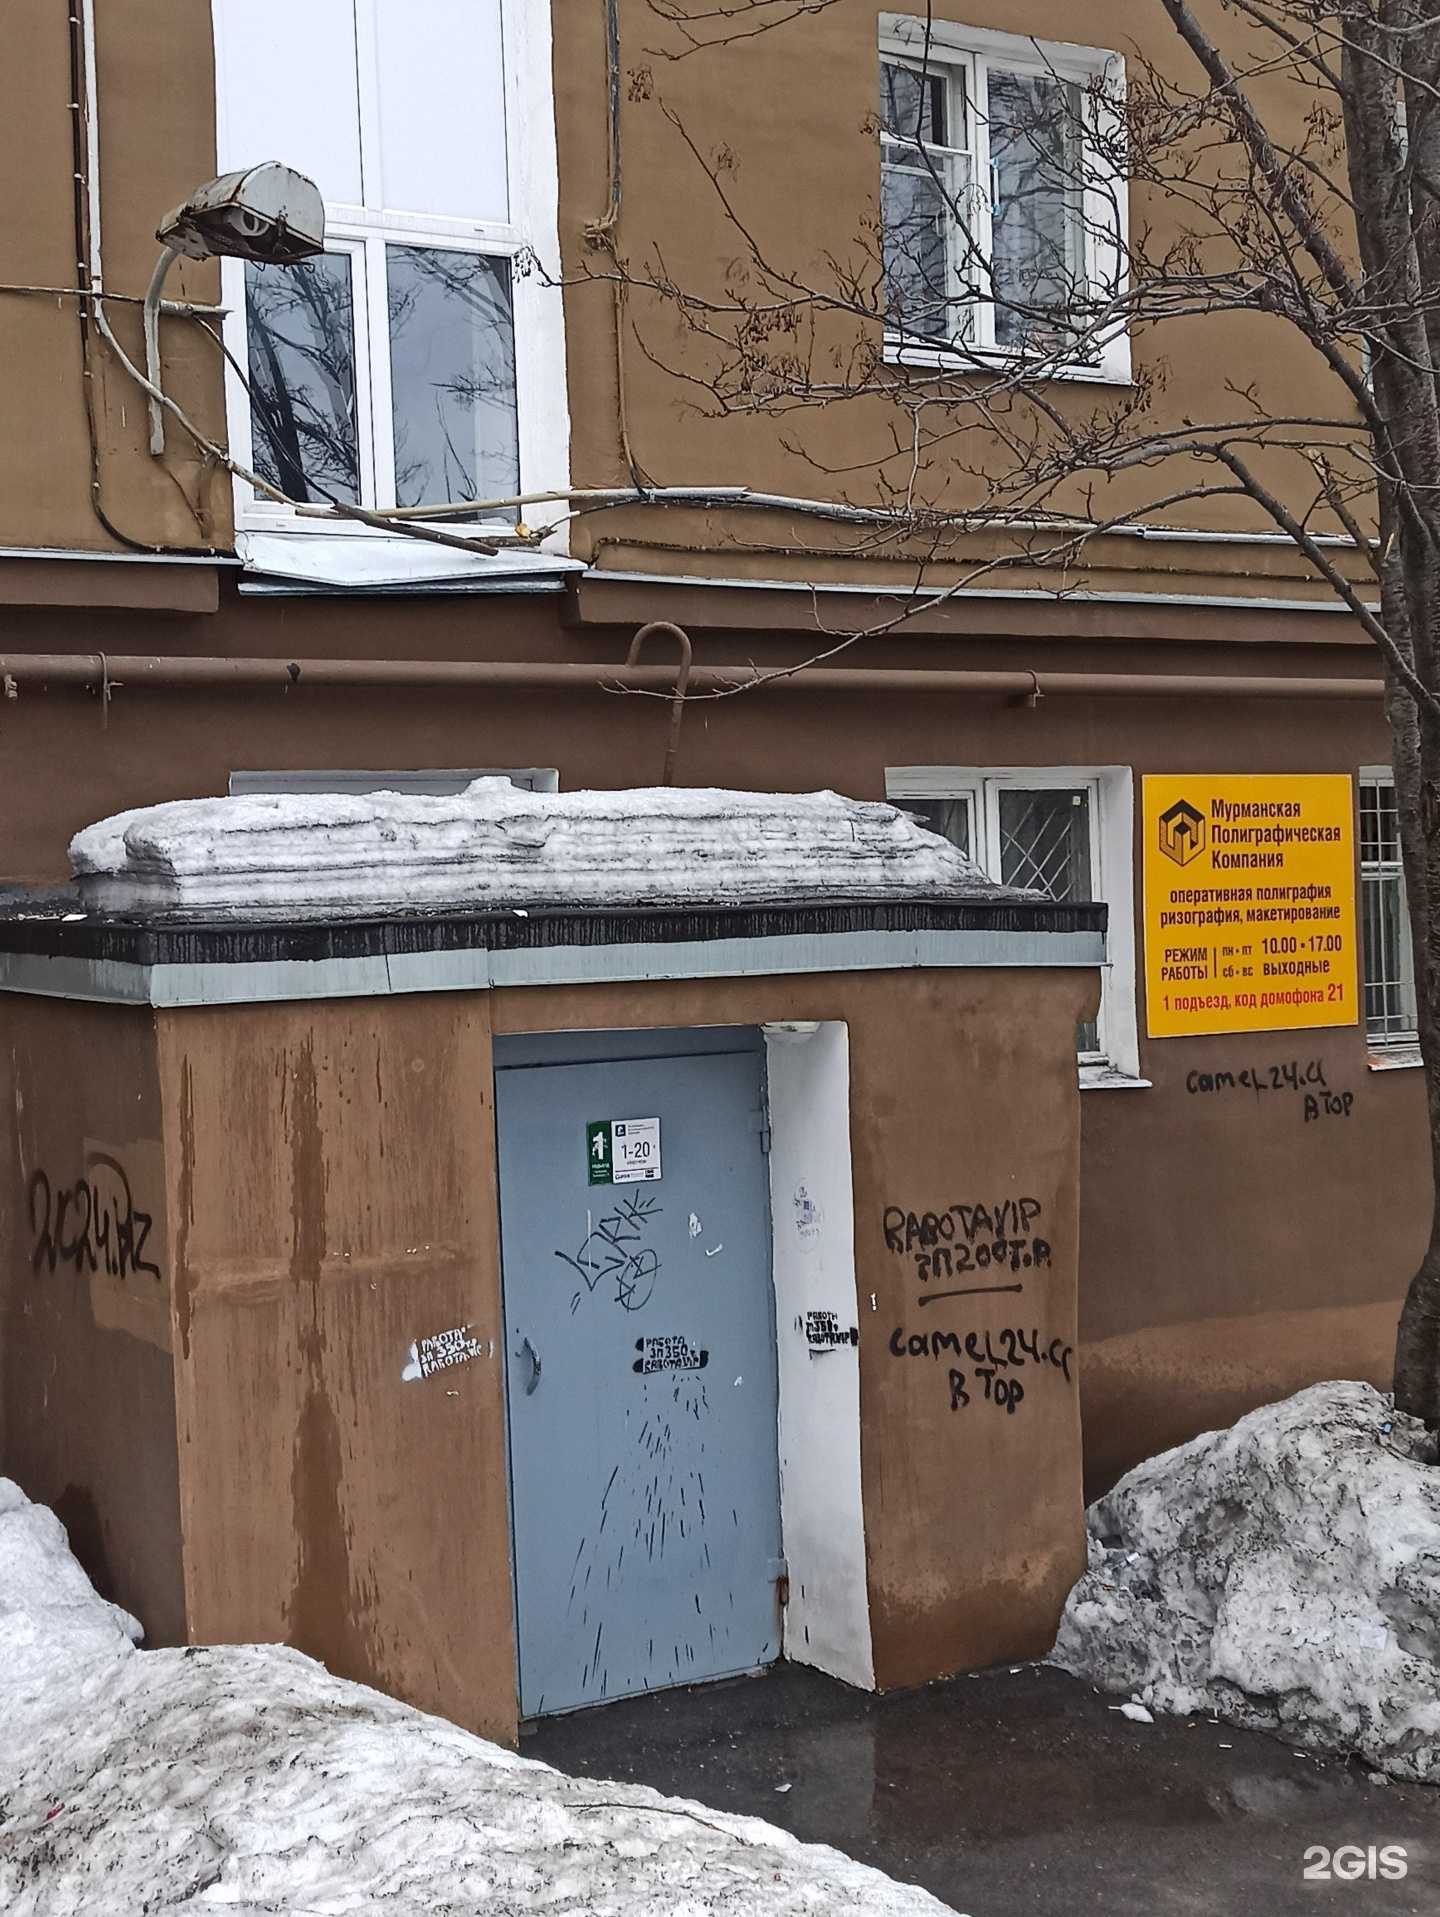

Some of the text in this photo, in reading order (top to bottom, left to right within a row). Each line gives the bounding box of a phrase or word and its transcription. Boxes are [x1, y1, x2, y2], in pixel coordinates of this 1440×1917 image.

[1211, 798, 1301, 822] Мурманская
[1211, 823, 1341, 847] Полиграфическая
[1211, 849, 1284, 870] Компания
[1170, 883, 1332, 906] оперативная полиграфия
[1160, 905, 1341, 928] ризография, макетирование
[1261, 936, 1297, 954] 10.00
[1308, 934, 1342, 953] 17.00
[1164, 947, 1208, 963] РЕЖИМ
[1161, 965, 1208, 981] РАБОТЫ
[1263, 959, 1330, 977] выходные
[1163, 983, 1344, 1012] 1 подъезд, код домофона 21
[621, 1141, 651, 1160] 1-20
